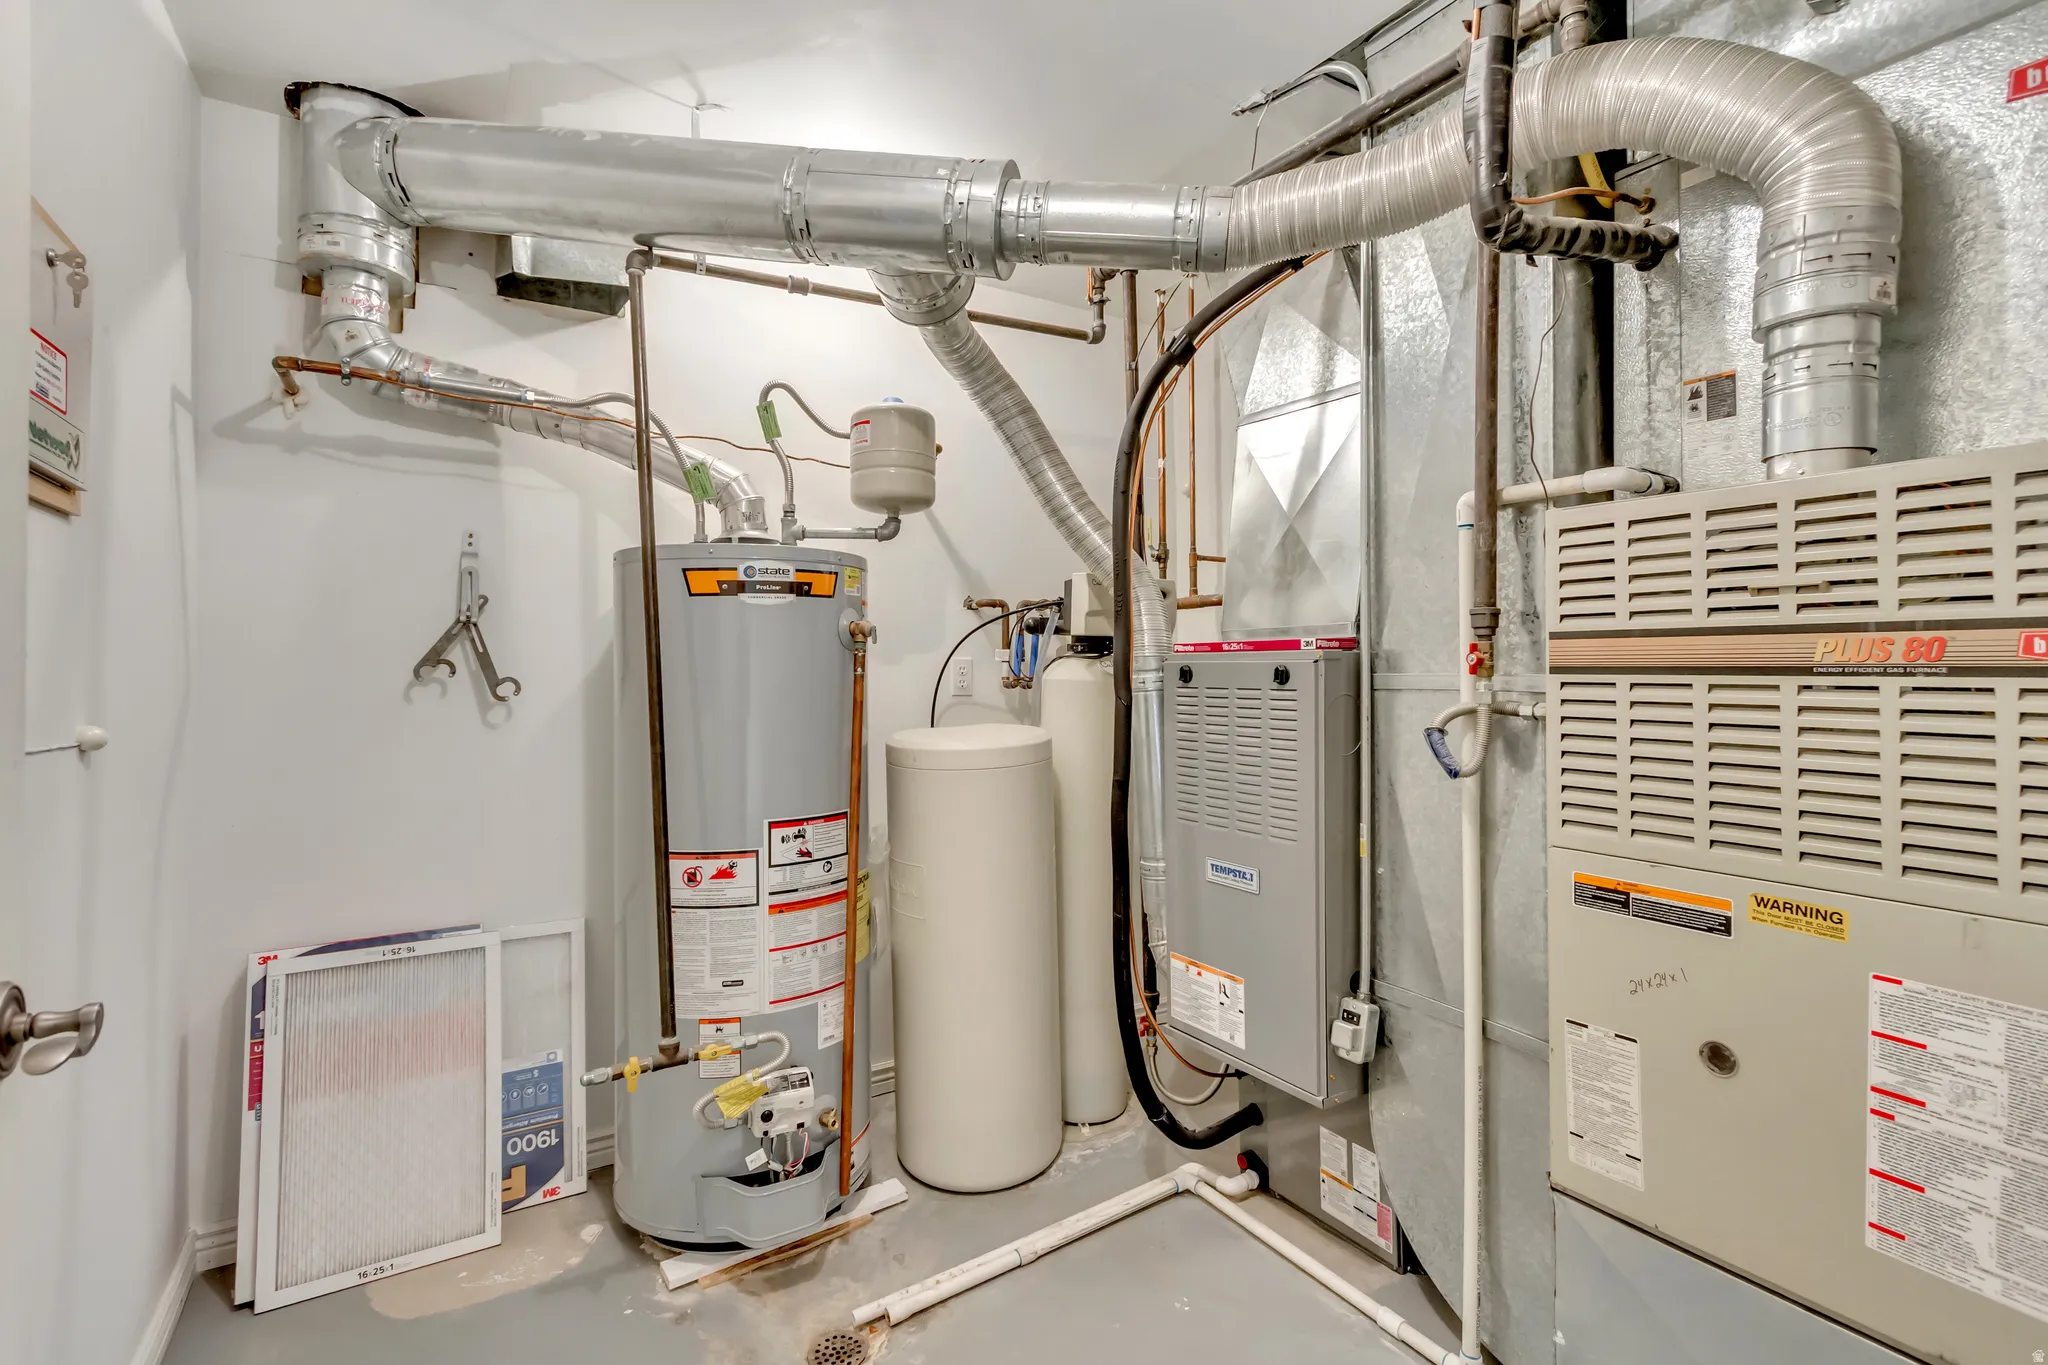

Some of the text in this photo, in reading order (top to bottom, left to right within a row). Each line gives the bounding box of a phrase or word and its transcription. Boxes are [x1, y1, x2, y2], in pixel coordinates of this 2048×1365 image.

[2026, 66, 2048, 89] b
[758, 567, 790, 576] state
[1303, 640, 1314, 648] 3M
[1813, 636, 1948, 664] PLUS 80
[1754, 894, 1843, 926] WARNING
[1751, 915, 1768, 923] When
[1770, 919, 1795, 929] Furnace
[1813, 929, 1846, 941] Operation
[1784, 916, 1802, 924] MUST
[1816, 922, 1845, 933] CLOSED
[507, 1129, 560, 1156] 1900
[542, 1185, 561, 1200] 3M
